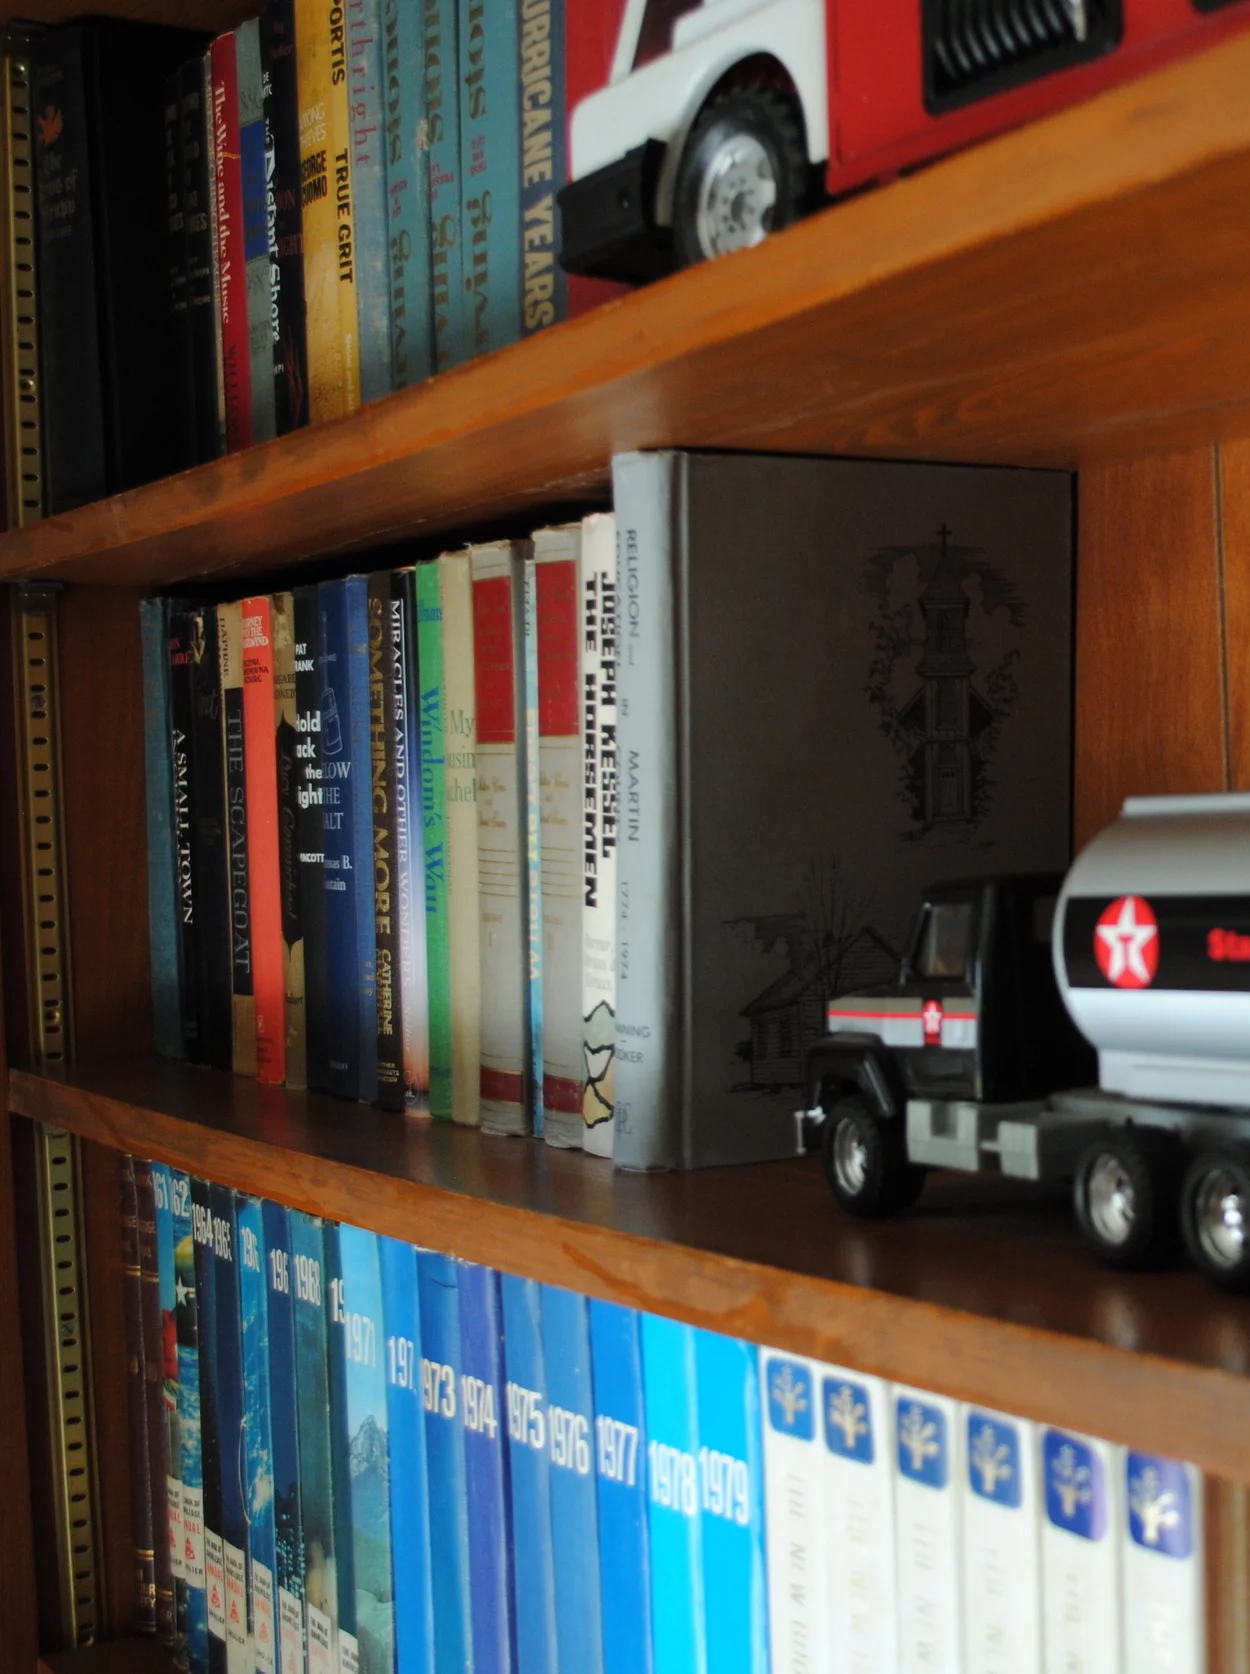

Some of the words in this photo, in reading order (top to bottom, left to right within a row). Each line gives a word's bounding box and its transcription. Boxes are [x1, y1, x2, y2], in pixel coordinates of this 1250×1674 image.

[350, 0, 376, 166] rthright
[521, 0, 552, 188] URRICANE
[217, 183, 229, 213] and
[335, 148, 350, 219] TRUE
[218, 217, 230, 257] the
[337, 221, 353, 284] GRIT
[465, 190, 491, 346] rving
[522, 193, 555, 330] YEARS
[219, 259, 232, 324] Music
[431, 214, 457, 364] rving
[585, 571, 599, 654] THE
[625, 529, 641, 638] RELIGION
[296, 660, 315, 672] RANK
[391, 600, 405, 721] MIRACLES
[600, 571, 617, 707] JOSEPH
[228, 709, 244, 772] THE
[367, 597, 389, 813] SOMETHING
[450, 709, 476, 735] My
[296, 737, 317, 759] ack
[305, 763, 323, 780] the
[321, 761, 352, 780] LOW
[395, 727, 406, 779] AND
[420, 685, 445, 828] Windom's
[447, 746, 476, 769] usin
[174, 751, 191, 838] SMALL
[297, 783, 324, 809] ight
[322, 812, 345, 830] ALT
[397, 784, 409, 863] OTHER
[447, 778, 478, 802] chel
[583, 673, 598, 908] HORSEMEN
[601, 724, 617, 859] KESSEL
[628, 750, 641, 841] MARTIN
[180, 842, 195, 926] TOWN
[229, 786, 251, 974] SCAPEGOAT
[372, 826, 391, 934] MORE
[423, 842, 445, 914] Way
[380, 948, 394, 1036] CATHERINE
[614, 1024, 652, 1040] NNING
[270, 1247, 289, 1294] 196
[293, 1254, 322, 1306] 1968
[329, 1277, 345, 1324] 19
[344, 1311, 377, 1369] 1971
[387, 1335, 417, 1397] 197
[421, 1357, 457, 1418] 973
[460, 1373, 498, 1439] 1974
[506, 1380, 547, 1449] 1975
[546, 1404, 591, 1475] 1976
[595, 1413, 639, 1487] 1977
[648, 1439, 697, 1516] 1978
[698, 1446, 750, 1527] 1979
